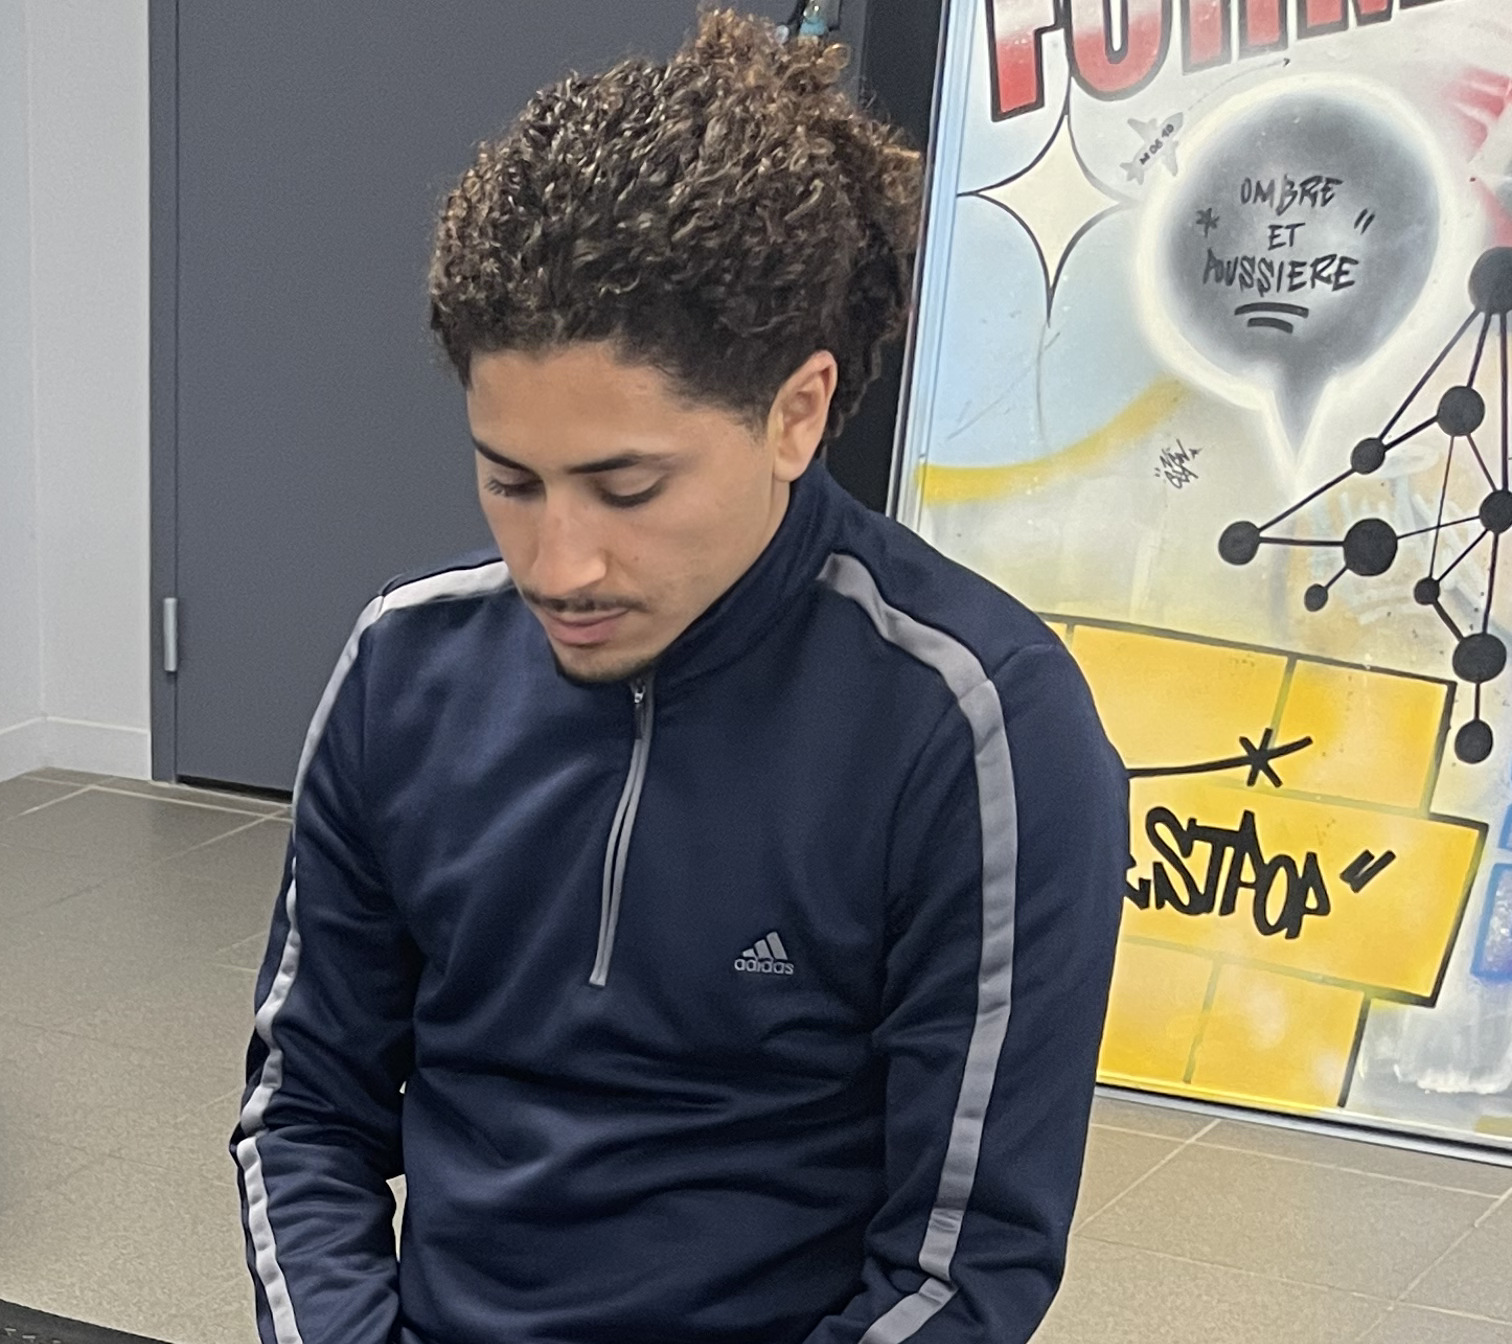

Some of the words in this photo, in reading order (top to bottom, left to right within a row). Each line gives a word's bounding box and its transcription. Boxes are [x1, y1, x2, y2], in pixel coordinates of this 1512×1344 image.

[1240, 174, 1344, 216] OMBRE
[1268, 222, 1306, 251] ET
[734, 955, 795, 975] adidas
